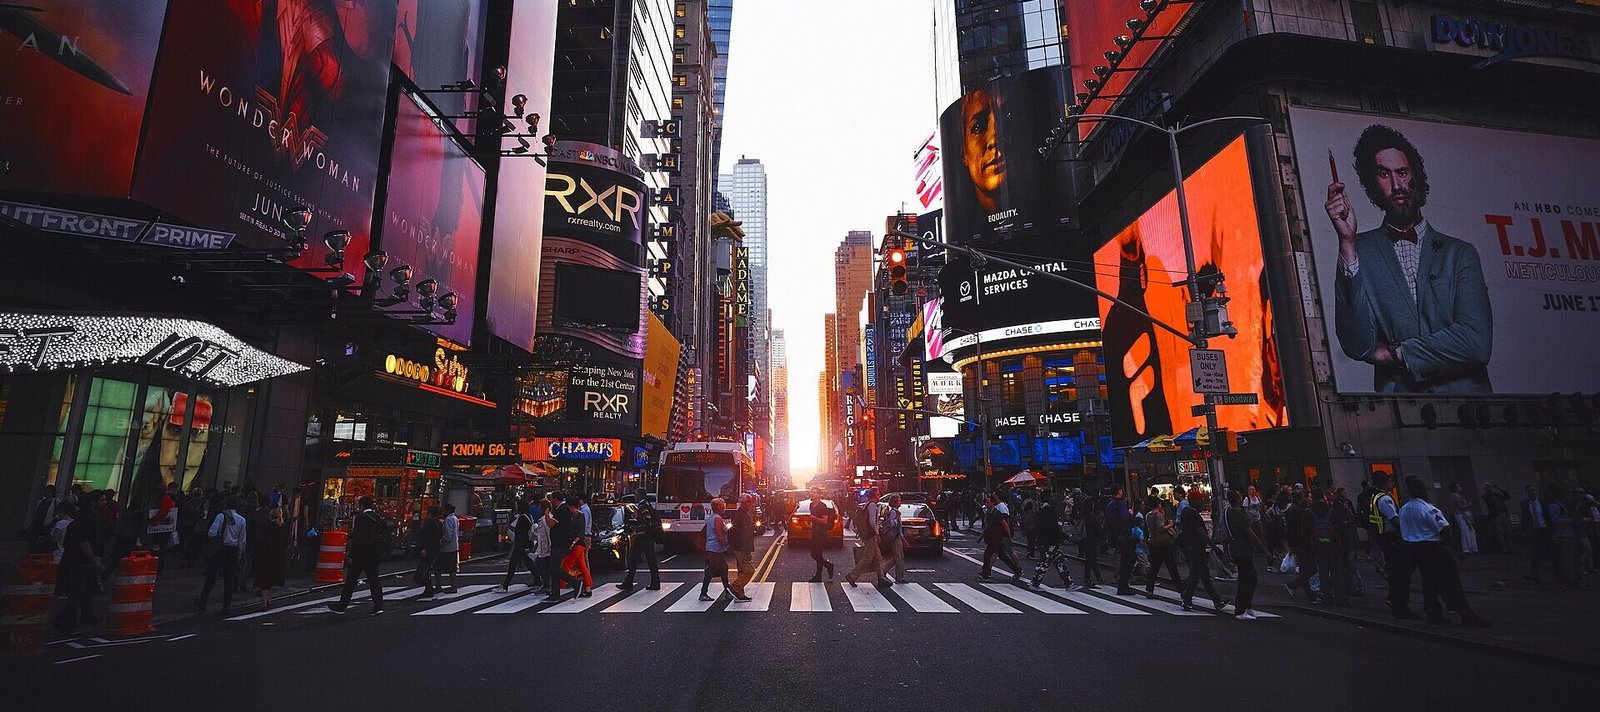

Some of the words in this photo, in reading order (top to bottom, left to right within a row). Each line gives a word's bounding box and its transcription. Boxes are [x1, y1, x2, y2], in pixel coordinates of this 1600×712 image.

[200, 69, 294, 149] WONDER
[301, 141, 360, 193] WOMAN
[205, 143, 220, 158] THE
[223, 154, 251, 175] FUTURE
[253, 171, 263, 181] OF
[265, 178, 291, 198] JUSTICE
[252, 193, 286, 222] JUN
[545, 173, 641, 231] RXR
[1514, 201, 1530, 212] AN
[1534, 203, 1562, 214] HBO
[567, 217, 621, 233] rxrrealty.com
[661, 123, 675, 310] CHAMPS
[154, 226, 225, 249] PRIME
[392, 211, 437, 253] WONDER
[1485, 214, 1560, 258] T.J.
[1560, 220, 1600, 260] M
[736, 247, 748, 315] MADAME
[983, 269, 1018, 284] MAZDA
[983, 279, 1029, 296] SERVICES
[1542, 293, 1586, 311] JUNE
[1004, 326, 1033, 337] CHASE
[146, 336, 240, 378] LOFT
[1196, 352, 1218, 361] BUSES
[607, 367, 622, 377] New
[1200, 362, 1217, 370] ONLY
[571, 376, 585, 386] for
[586, 377, 600, 387] the
[600, 378, 614, 389] 21st
[614, 379, 636, 394] Century
[913, 358, 922, 396] VICTORY
[583, 391, 629, 414] RXR
[914, 400, 923, 419] NW
[593, 411, 622, 419] REALTY
[846, 395, 855, 447] REGAL
[995, 416, 1026, 427] CHASE
[1039, 412, 1080, 424] CHASE
[452, 443, 484, 457] KNOW
[549, 441, 613, 458] CHAMPS
[1179, 461, 1200, 473] SODA
